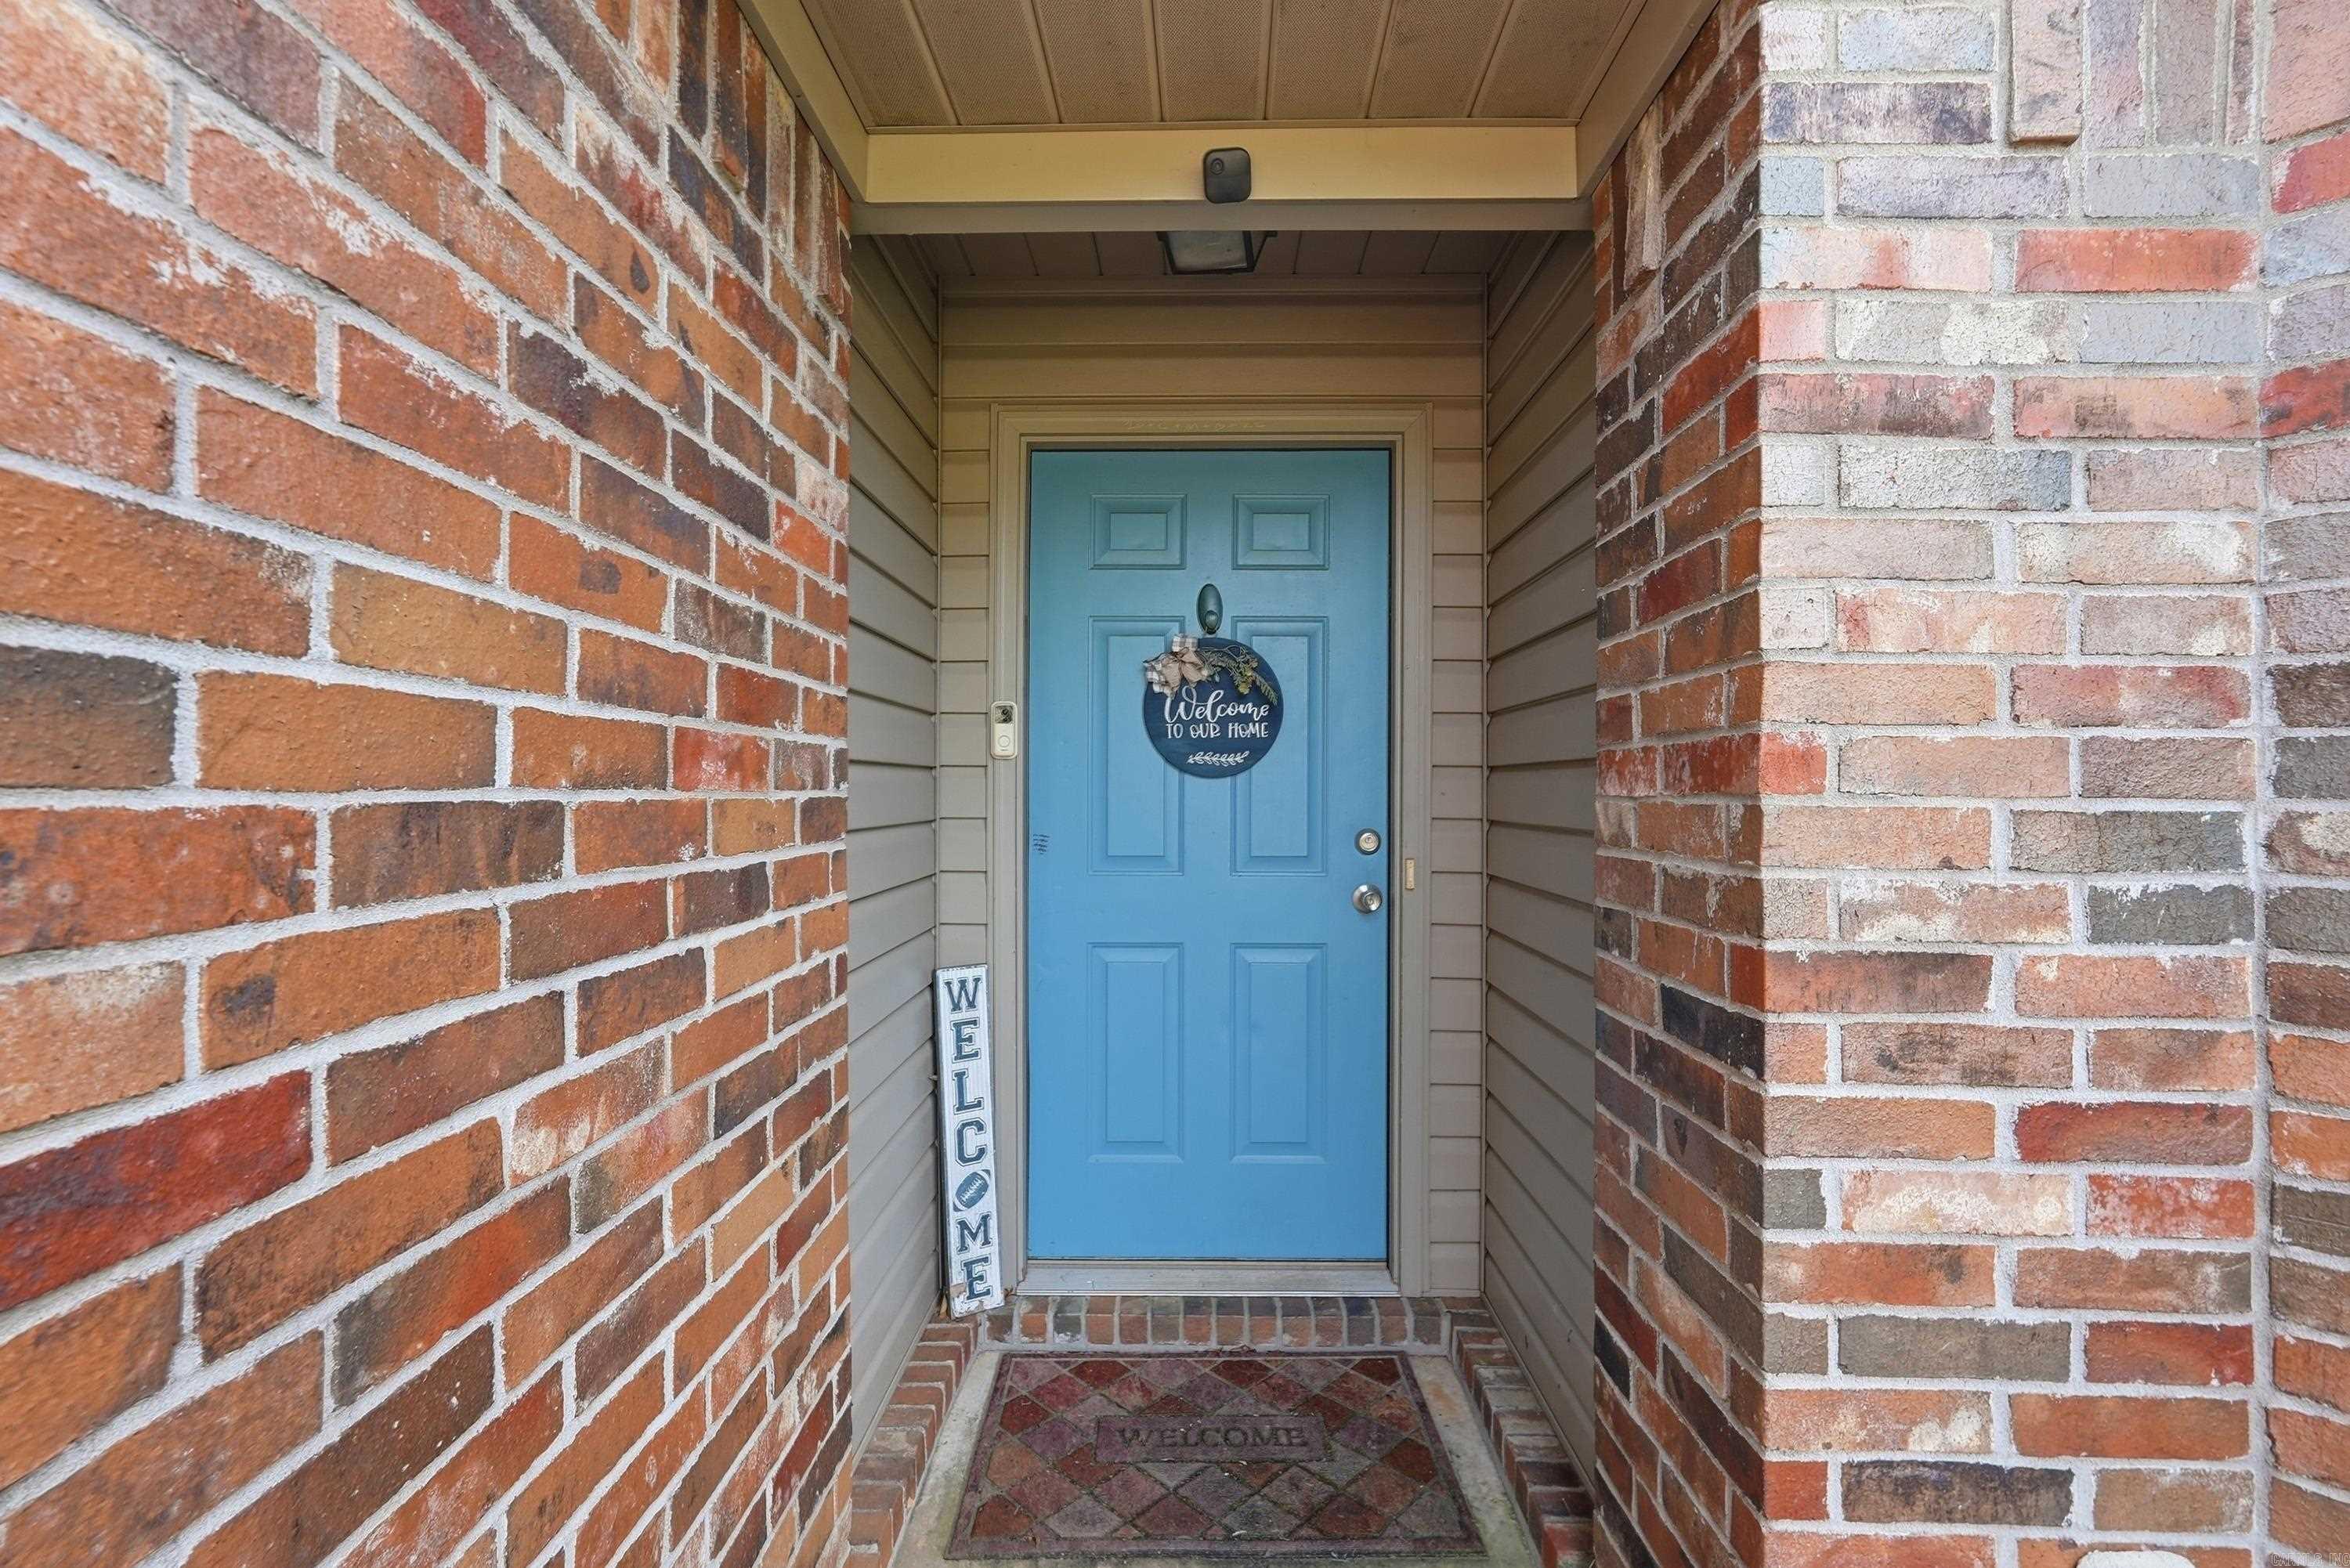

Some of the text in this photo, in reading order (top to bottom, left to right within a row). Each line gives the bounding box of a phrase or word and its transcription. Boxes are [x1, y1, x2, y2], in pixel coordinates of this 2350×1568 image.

[1164, 686, 1269, 723] Welcome
[1166, 722, 1269, 739] TO OUR HOME
[1115, 1426, 1310, 1448] WELCOME
